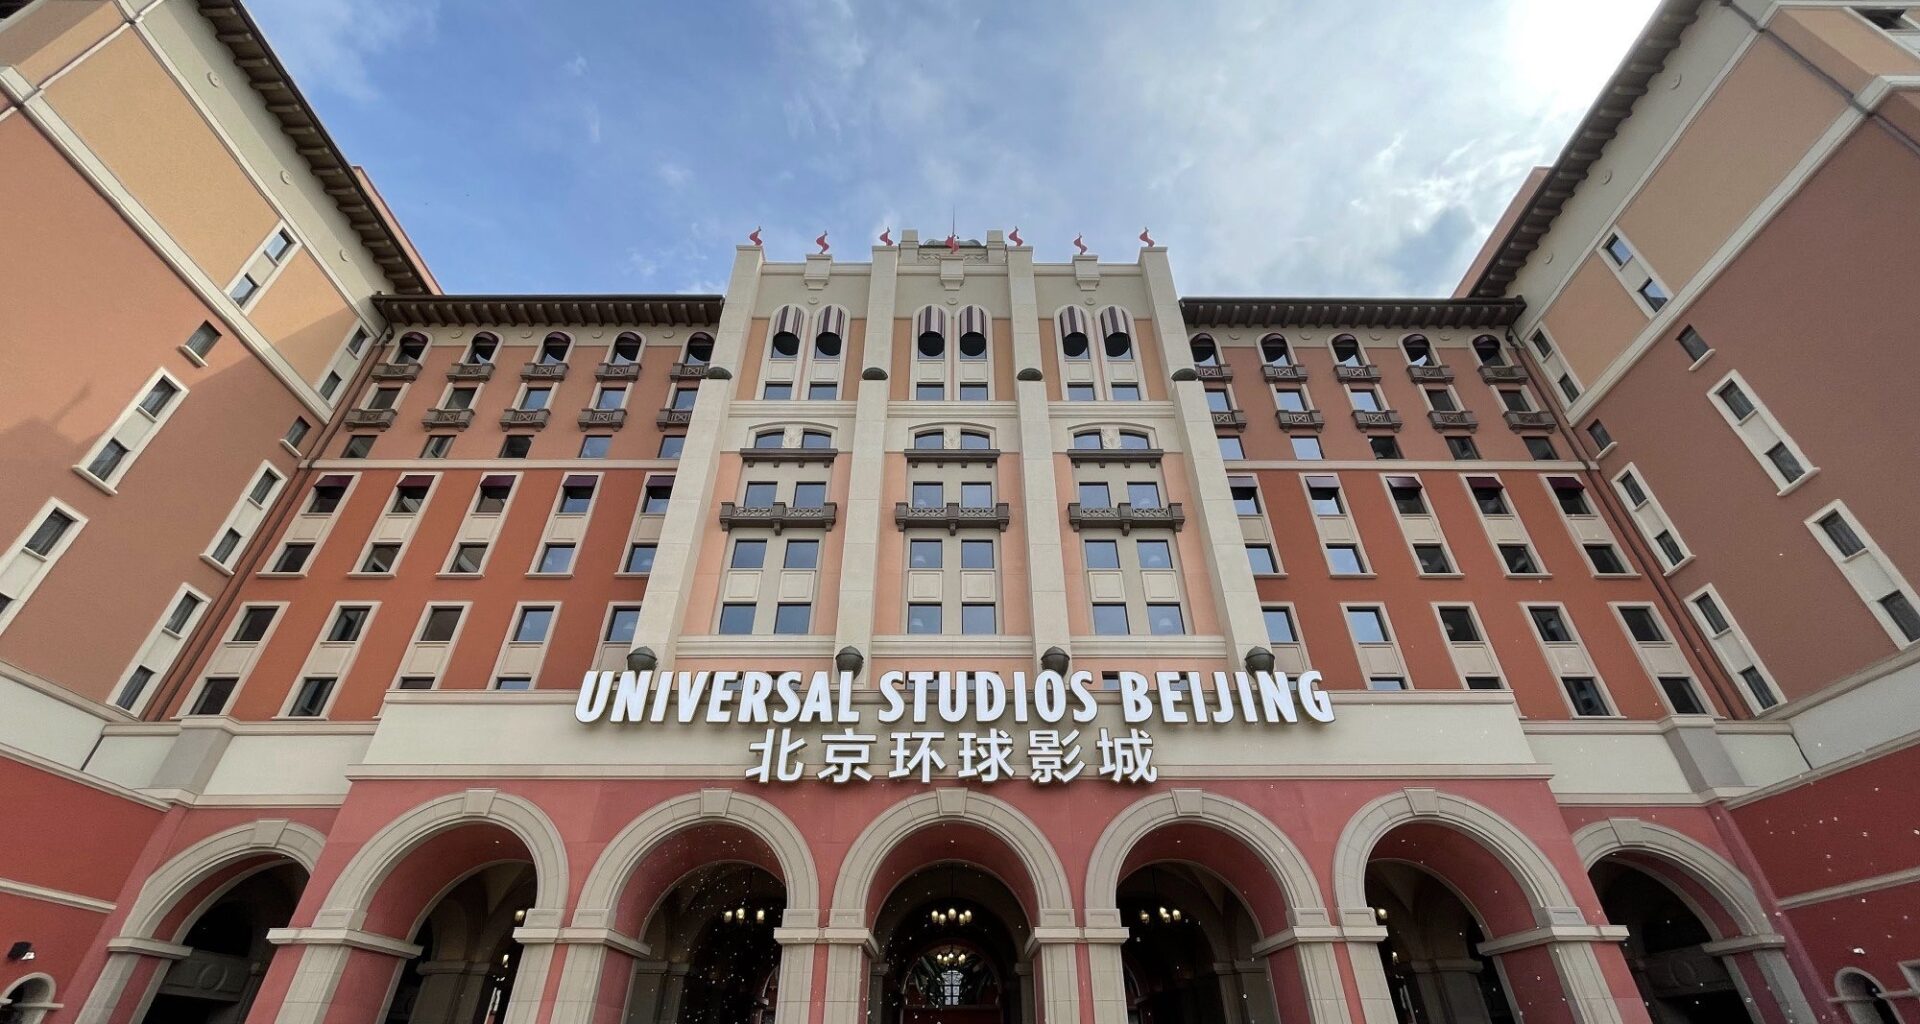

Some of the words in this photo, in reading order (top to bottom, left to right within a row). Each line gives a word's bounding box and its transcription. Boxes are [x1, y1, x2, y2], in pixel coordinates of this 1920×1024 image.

[575, 670, 860, 724] UNIVERSAL
[878, 670, 1098, 724] STUDIOS
[1121, 670, 1335, 724] BEIJING
[745, 728, 1158, 784] 北京环球影城
